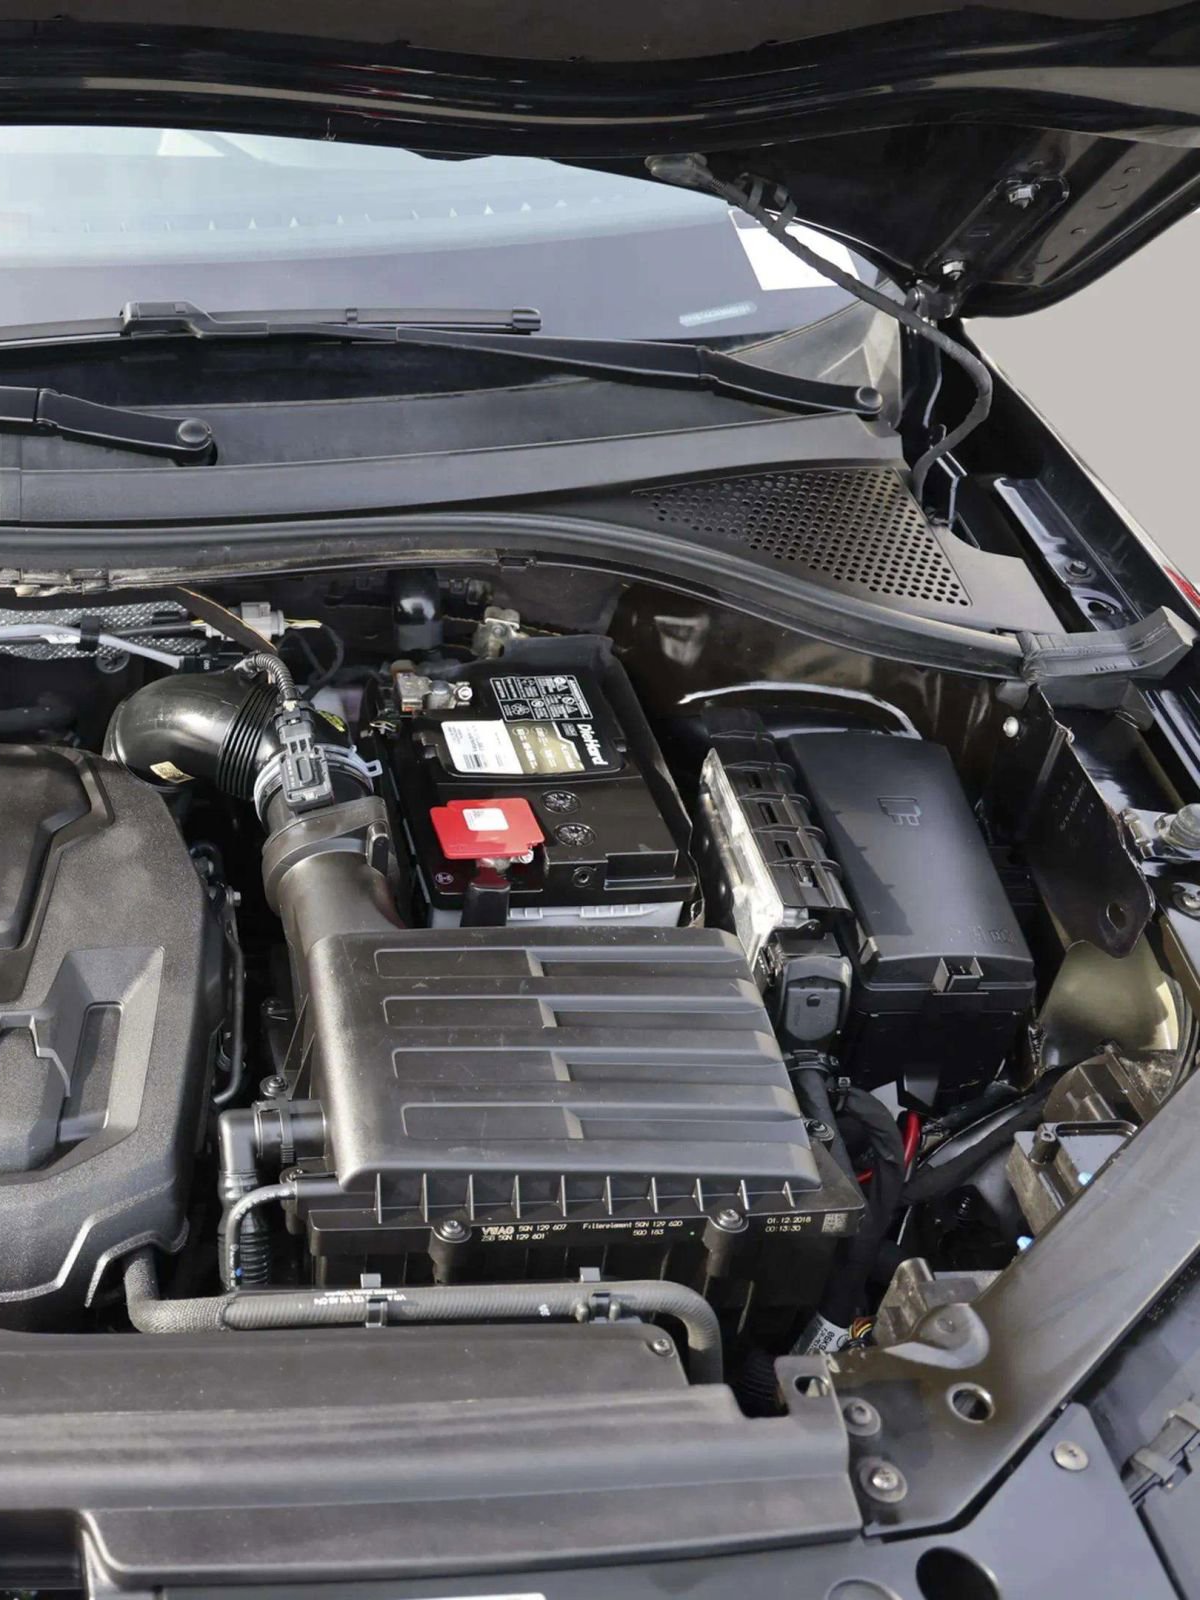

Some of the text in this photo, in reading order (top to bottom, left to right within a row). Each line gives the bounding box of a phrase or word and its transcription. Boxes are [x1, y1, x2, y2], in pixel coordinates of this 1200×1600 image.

[576, 723, 609, 766] DieHard
[653, 1220, 667, 1228] 129
[516, 1233, 530, 1241] 129
